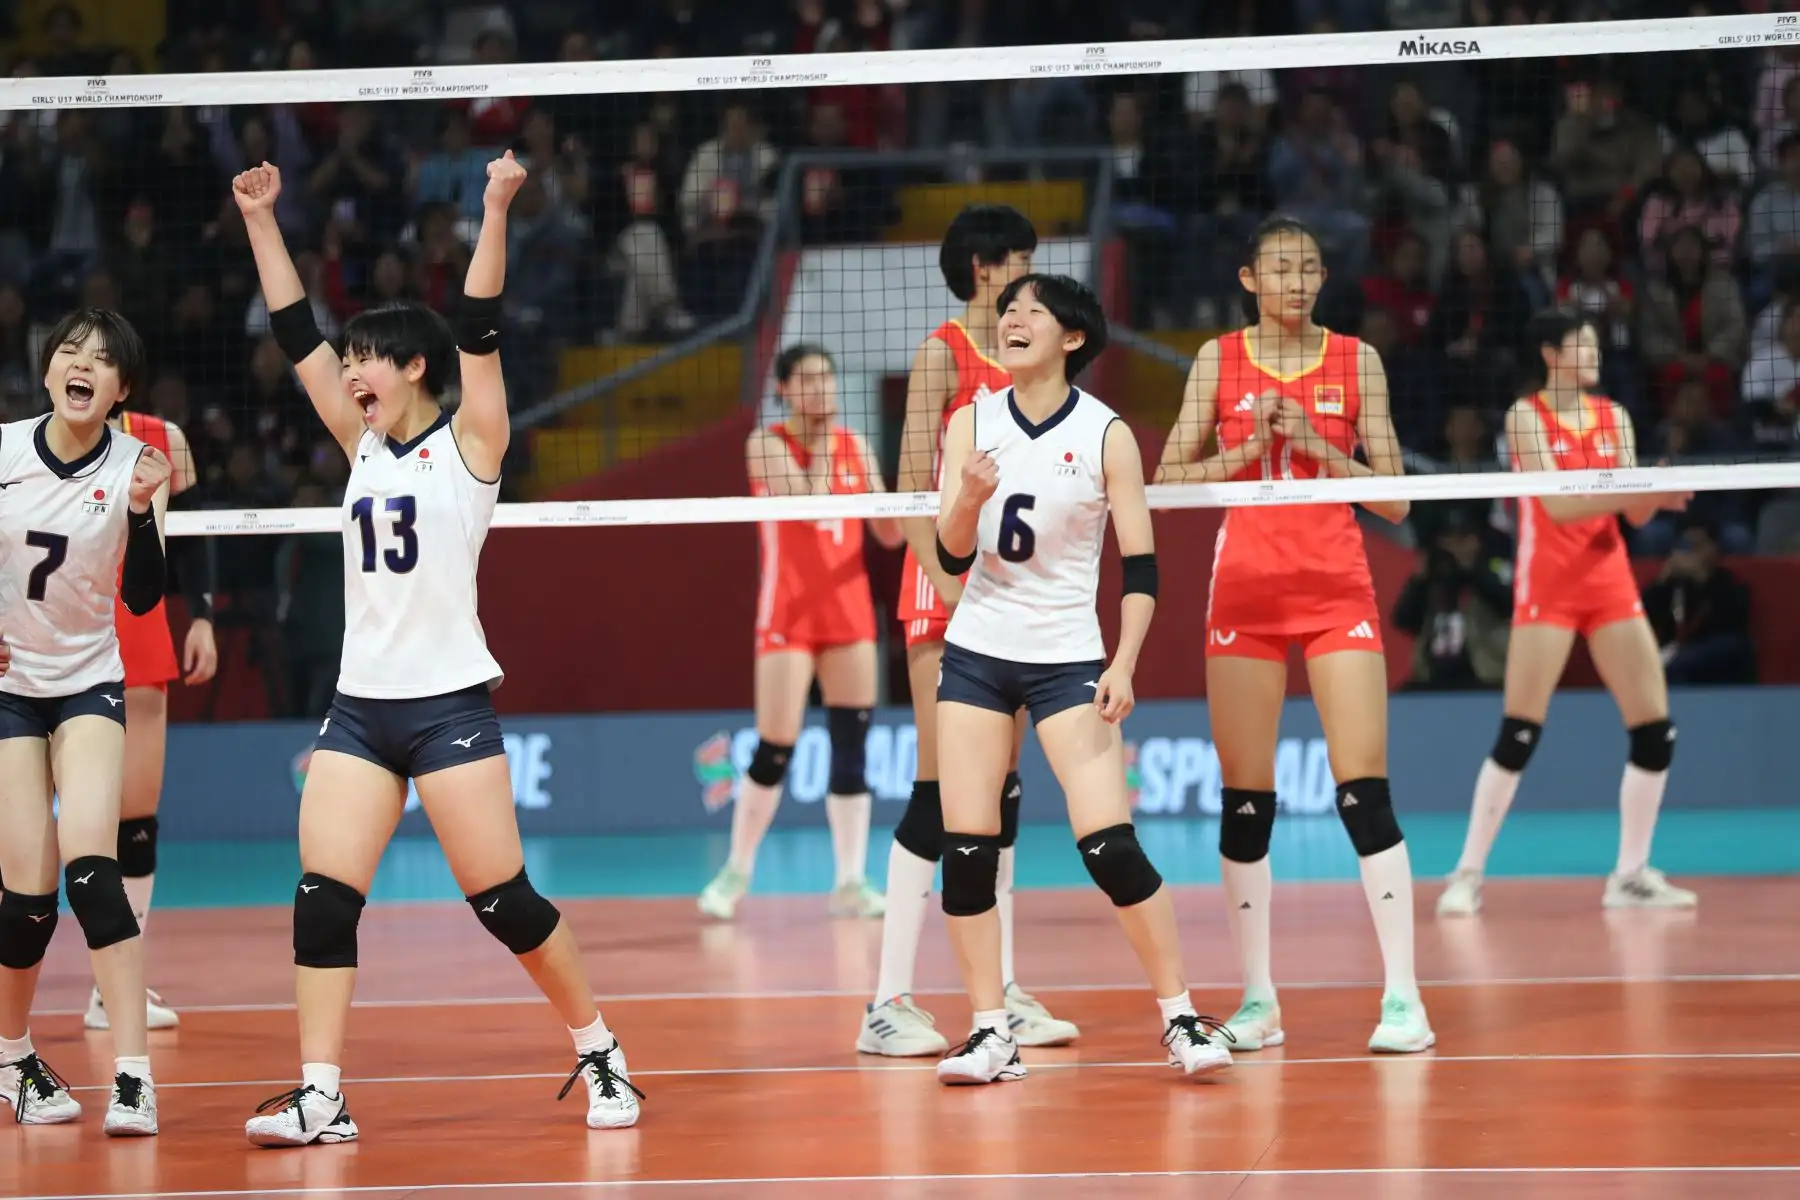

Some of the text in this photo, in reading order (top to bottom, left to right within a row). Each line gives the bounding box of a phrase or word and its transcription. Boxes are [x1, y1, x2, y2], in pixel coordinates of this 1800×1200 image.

[1764, 33, 1793, 41] WORLD
[1074, 63, 1100, 71] WORLD
[1102, 61, 1162, 70] CHAMPIONSHIP
[741, 75, 767, 84] WORLD
[769, 73, 828, 83] CHAMPIONSHIP
[402, 86, 429, 94] WORLD
[431, 84, 489, 93] CHAMPIONSHIP
[76, 95, 103, 103] WORLD
[105, 94, 163, 102] CHAMPIONSHIP
[997, 492, 1036, 563] 6
[351, 495, 419, 575] 13
[25, 529, 69, 601] 7
